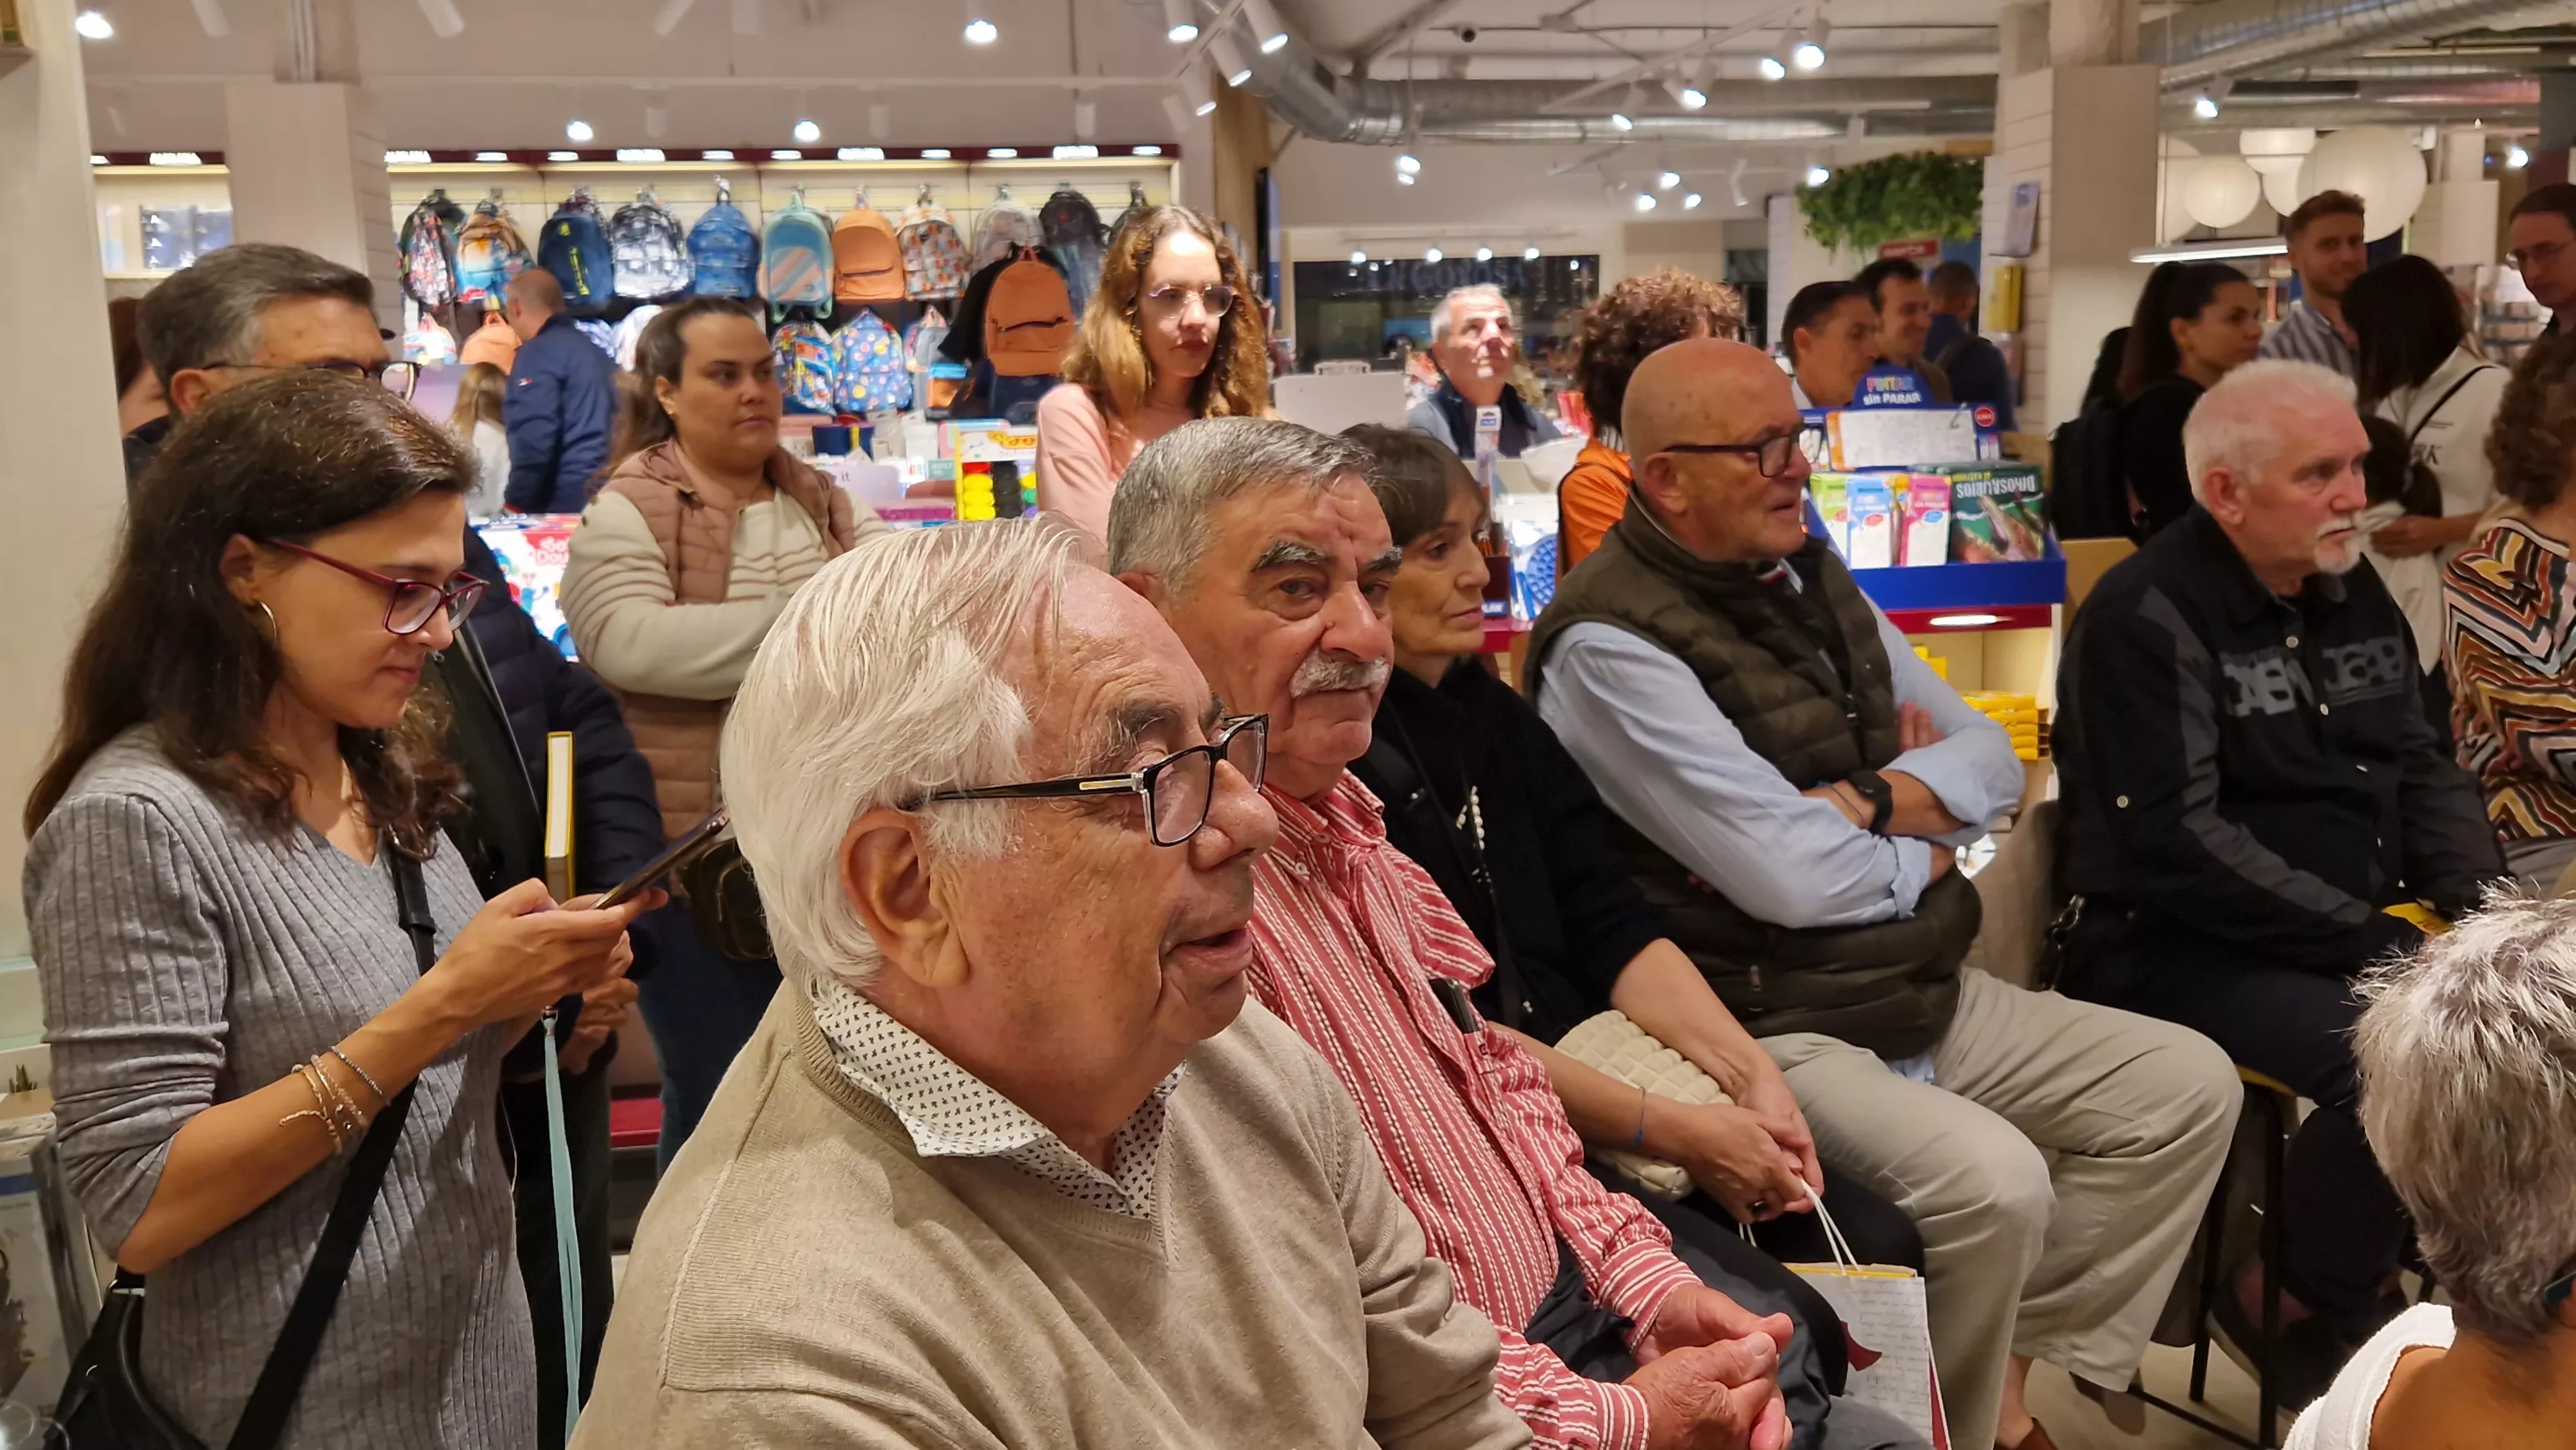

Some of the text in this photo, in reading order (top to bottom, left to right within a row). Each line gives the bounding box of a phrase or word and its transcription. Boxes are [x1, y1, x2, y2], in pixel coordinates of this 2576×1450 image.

[1863, 392, 1922, 406] sin PARAR
[841, 471, 851, 482] it
[1955, 475, 2036, 499] DINOSAURIOS
